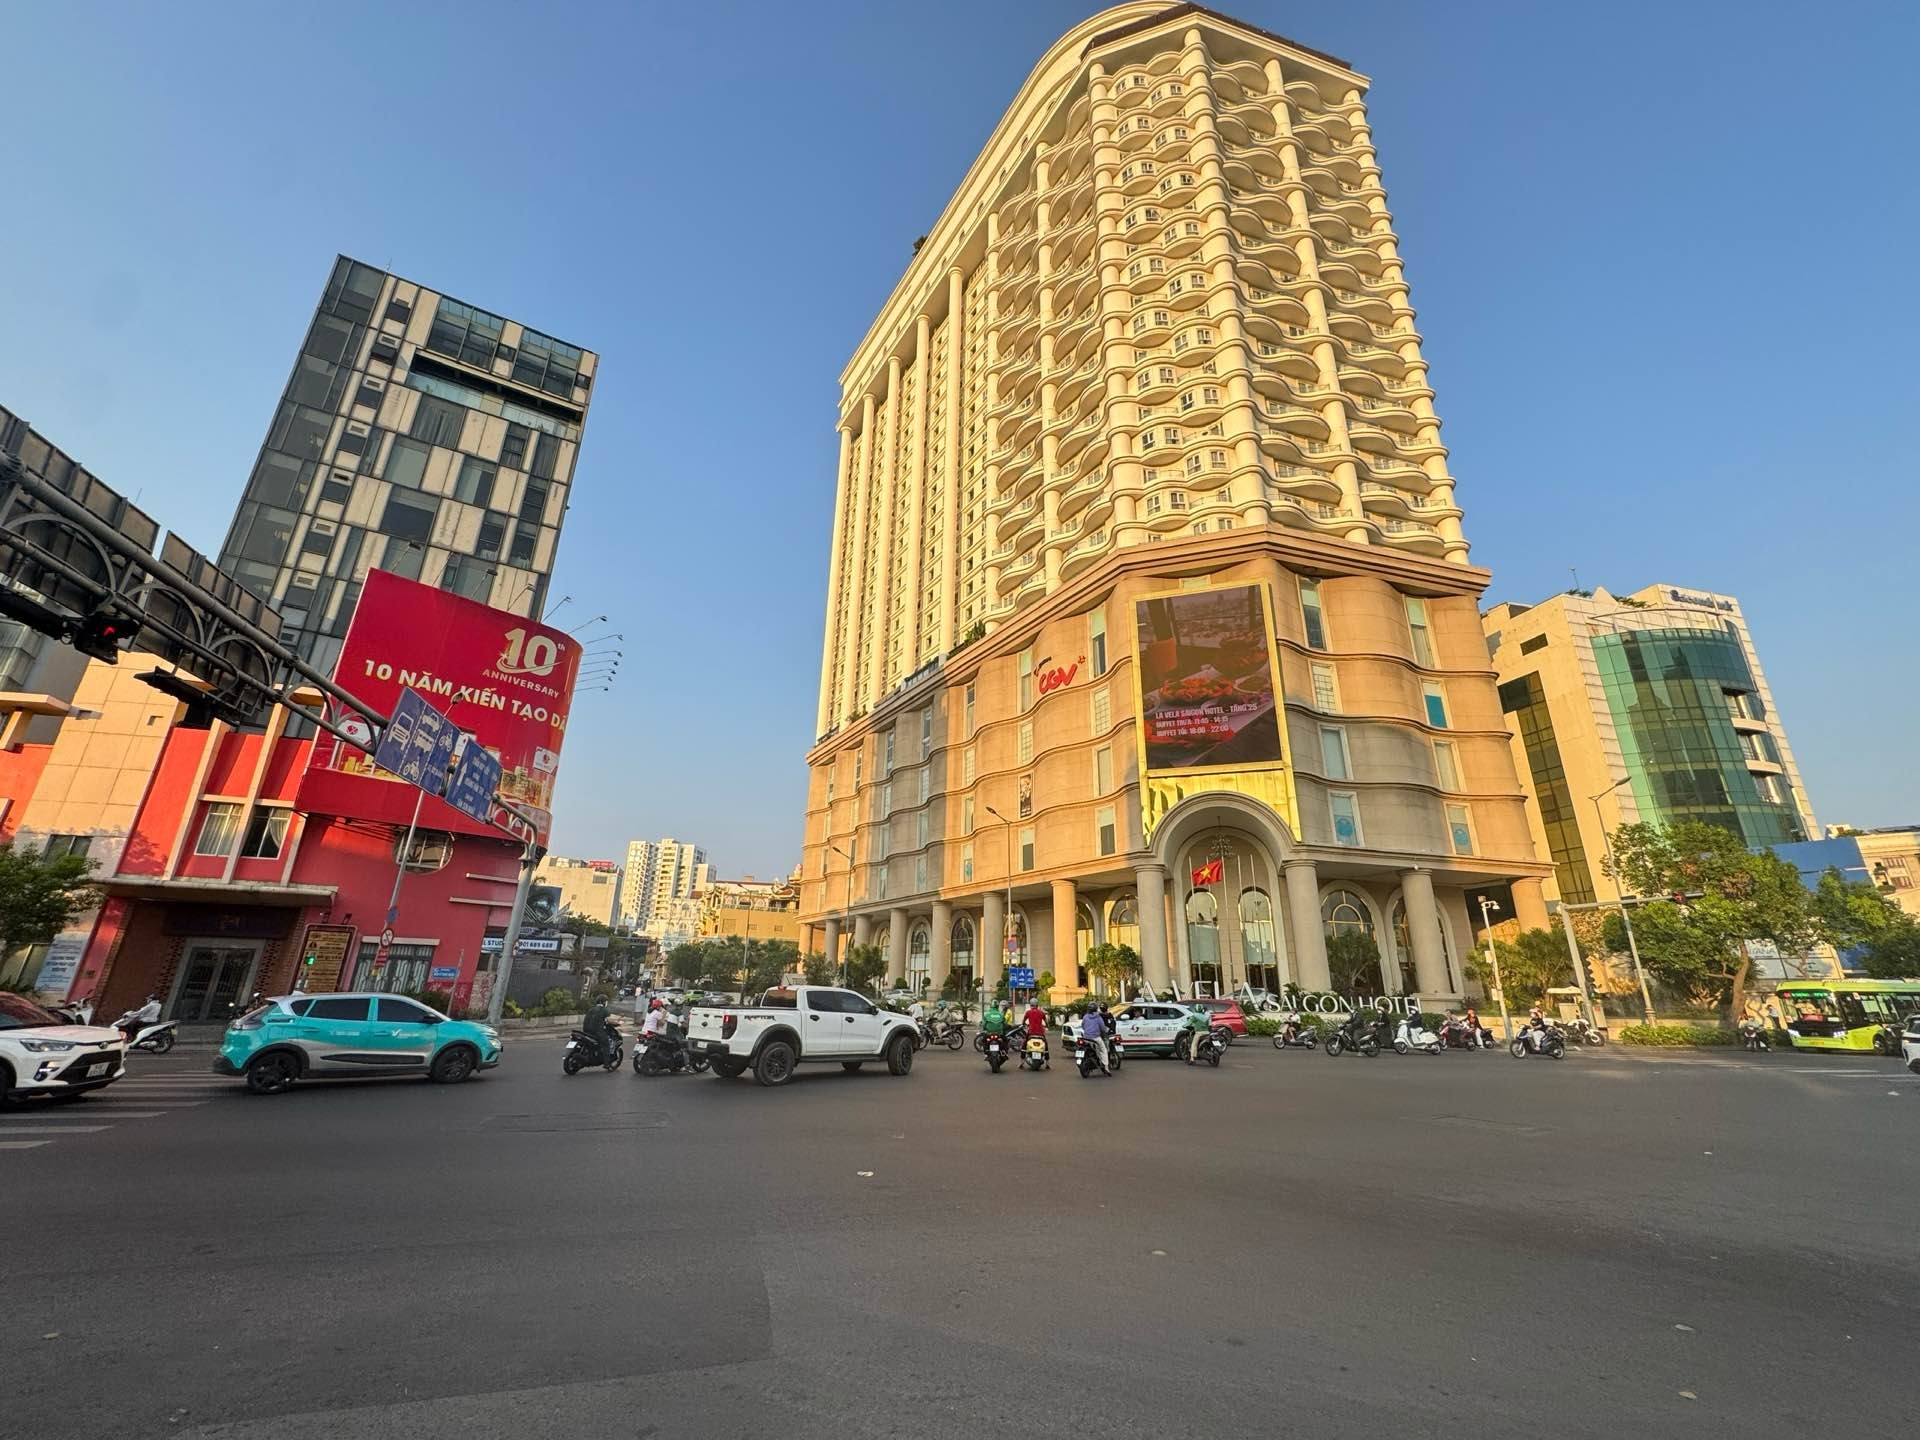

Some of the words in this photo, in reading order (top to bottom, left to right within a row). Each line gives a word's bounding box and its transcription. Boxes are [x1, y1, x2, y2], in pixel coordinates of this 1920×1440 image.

[502, 628, 558, 676] 10
[365, 659, 393, 681] 10
[398, 669, 453, 696] NĂM
[459, 686, 505, 711] KIẾN
[511, 700, 548, 722] TẠO
[482, 668, 560, 698] ANNIVERSARY
[1039, 664, 1078, 694] CGV
